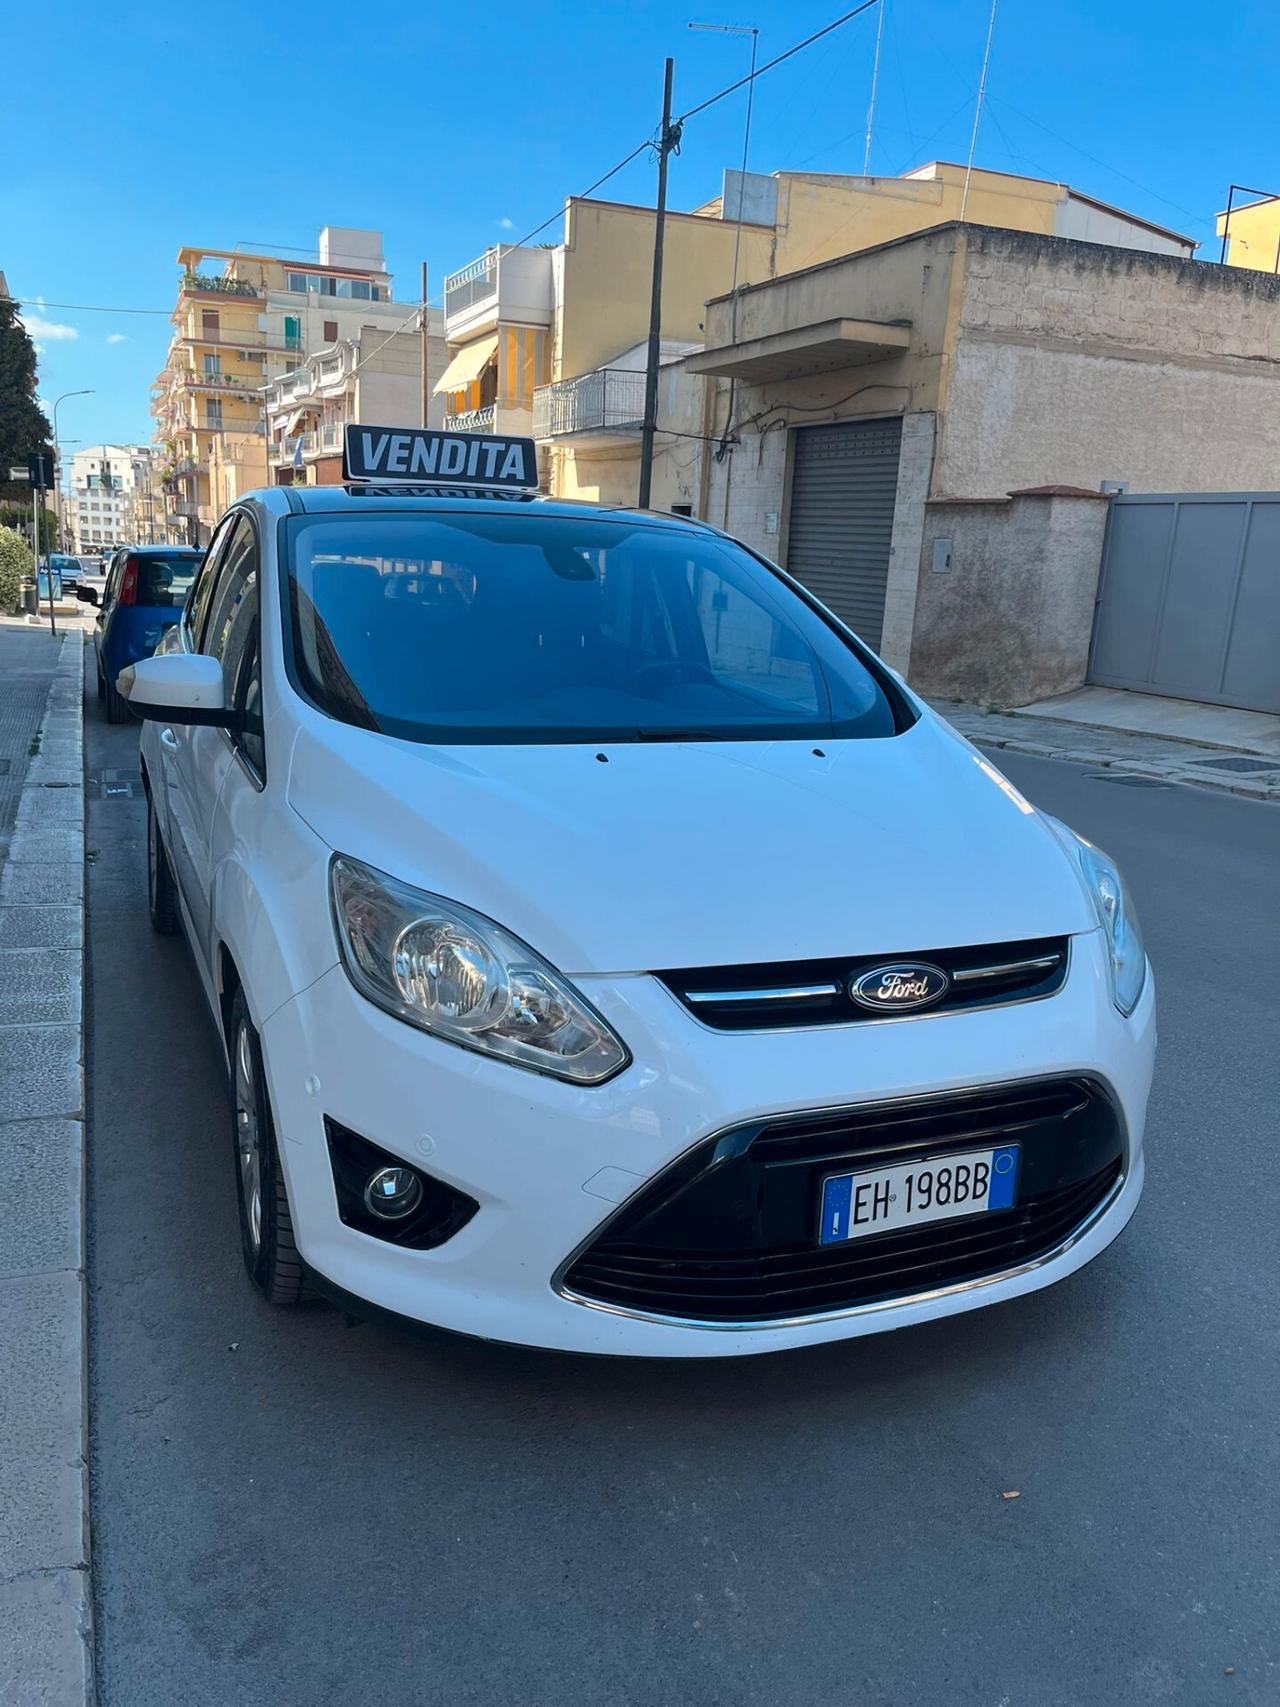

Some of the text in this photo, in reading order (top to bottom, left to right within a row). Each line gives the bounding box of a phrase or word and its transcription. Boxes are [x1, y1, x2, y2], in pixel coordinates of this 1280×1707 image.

[362, 432, 526, 481] VENDITA
[877, 971, 929, 1000] Ford
[853, 1161, 990, 1226] EH 198BB
